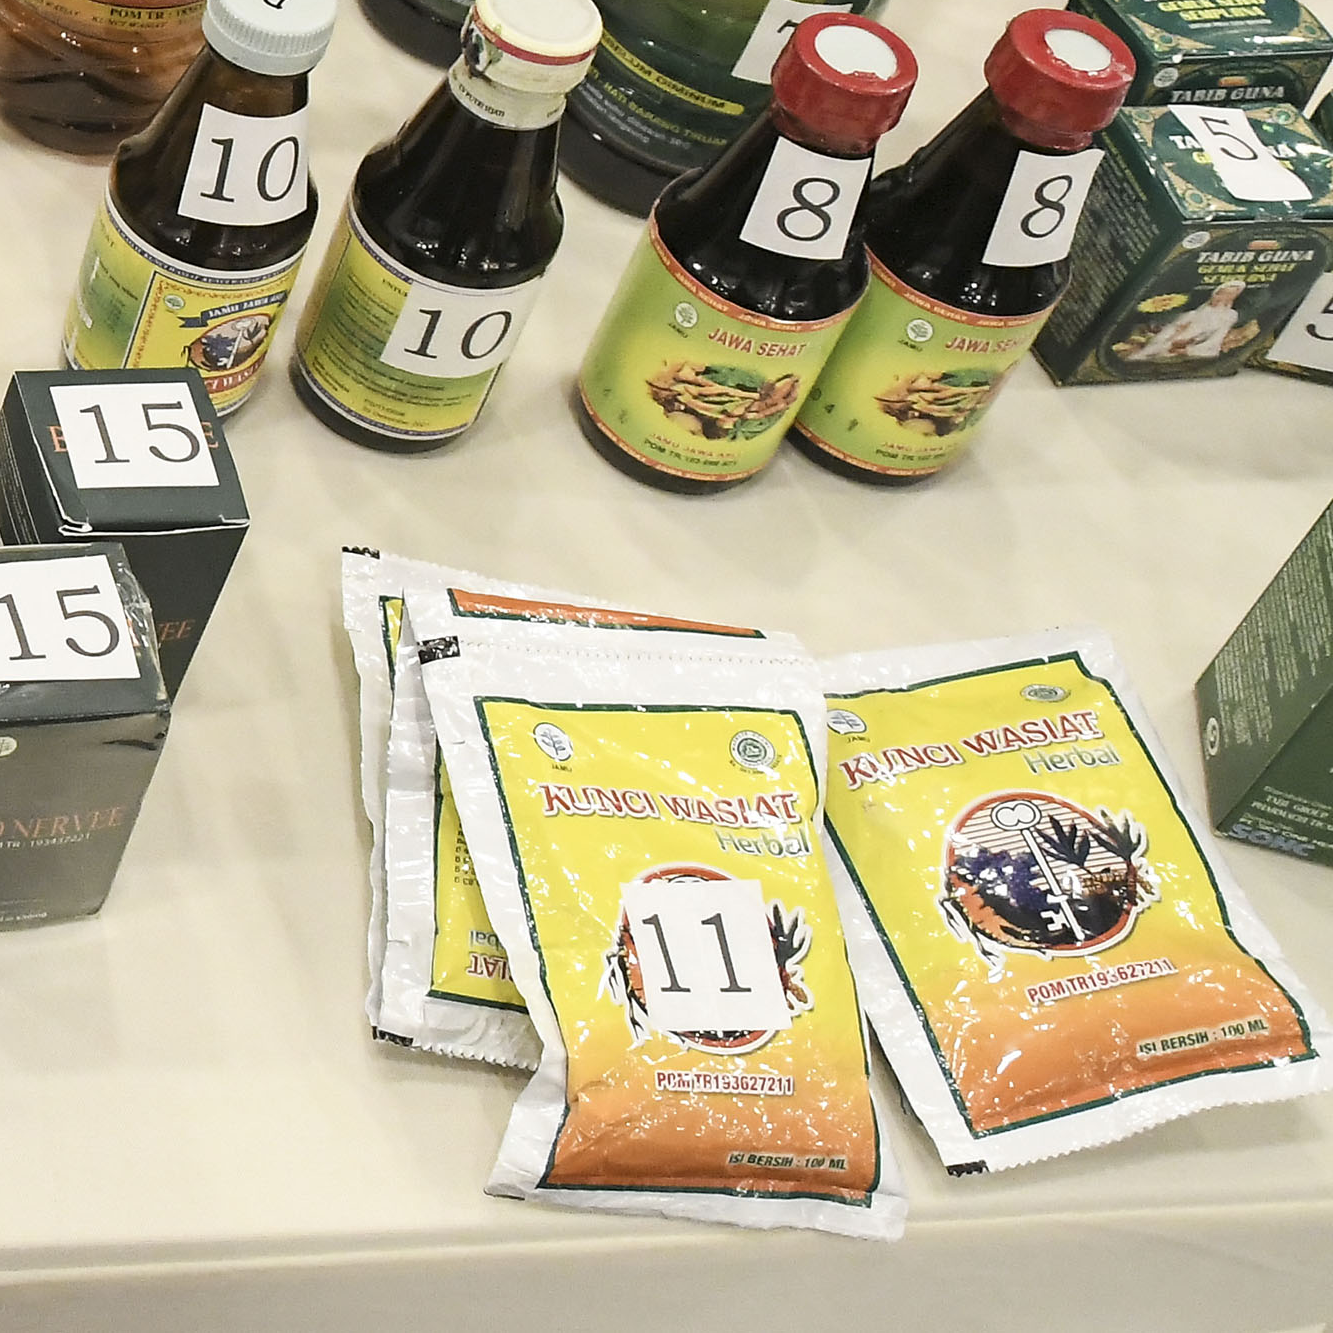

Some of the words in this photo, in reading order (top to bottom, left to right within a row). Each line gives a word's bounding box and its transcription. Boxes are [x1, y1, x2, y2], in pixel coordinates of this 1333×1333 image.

[1199, 116, 1258, 161] 5
[199, 135, 300, 203] 10
[776, 177, 841, 242] 8
[1020, 174, 1074, 239] 8
[1197, 250, 1260, 263] TABIB
[1263, 249, 1315, 262] GUNA
[403, 309, 512, 360] 10
[708, 327, 754, 354] JAWA
[756, 339, 808, 358] SEHAT
[79, 400, 202, 465] 15
[839, 742, 964, 790] KUNCI
[965, 710, 1102, 757] WASIAT
[1029, 745, 1121, 777] Herbal
[540, 782, 658, 818] KUNCI
[661, 791, 802, 827] WASIAT
[715, 827, 811, 857] Herbal
[642, 912, 753, 994] 11
[1139, 1041, 1158, 1056] ISI
[1161, 1032, 1209, 1054] BERSIH
[1221, 1023, 1247, 1039] 100
[1250, 1019, 1269, 1034] ML
